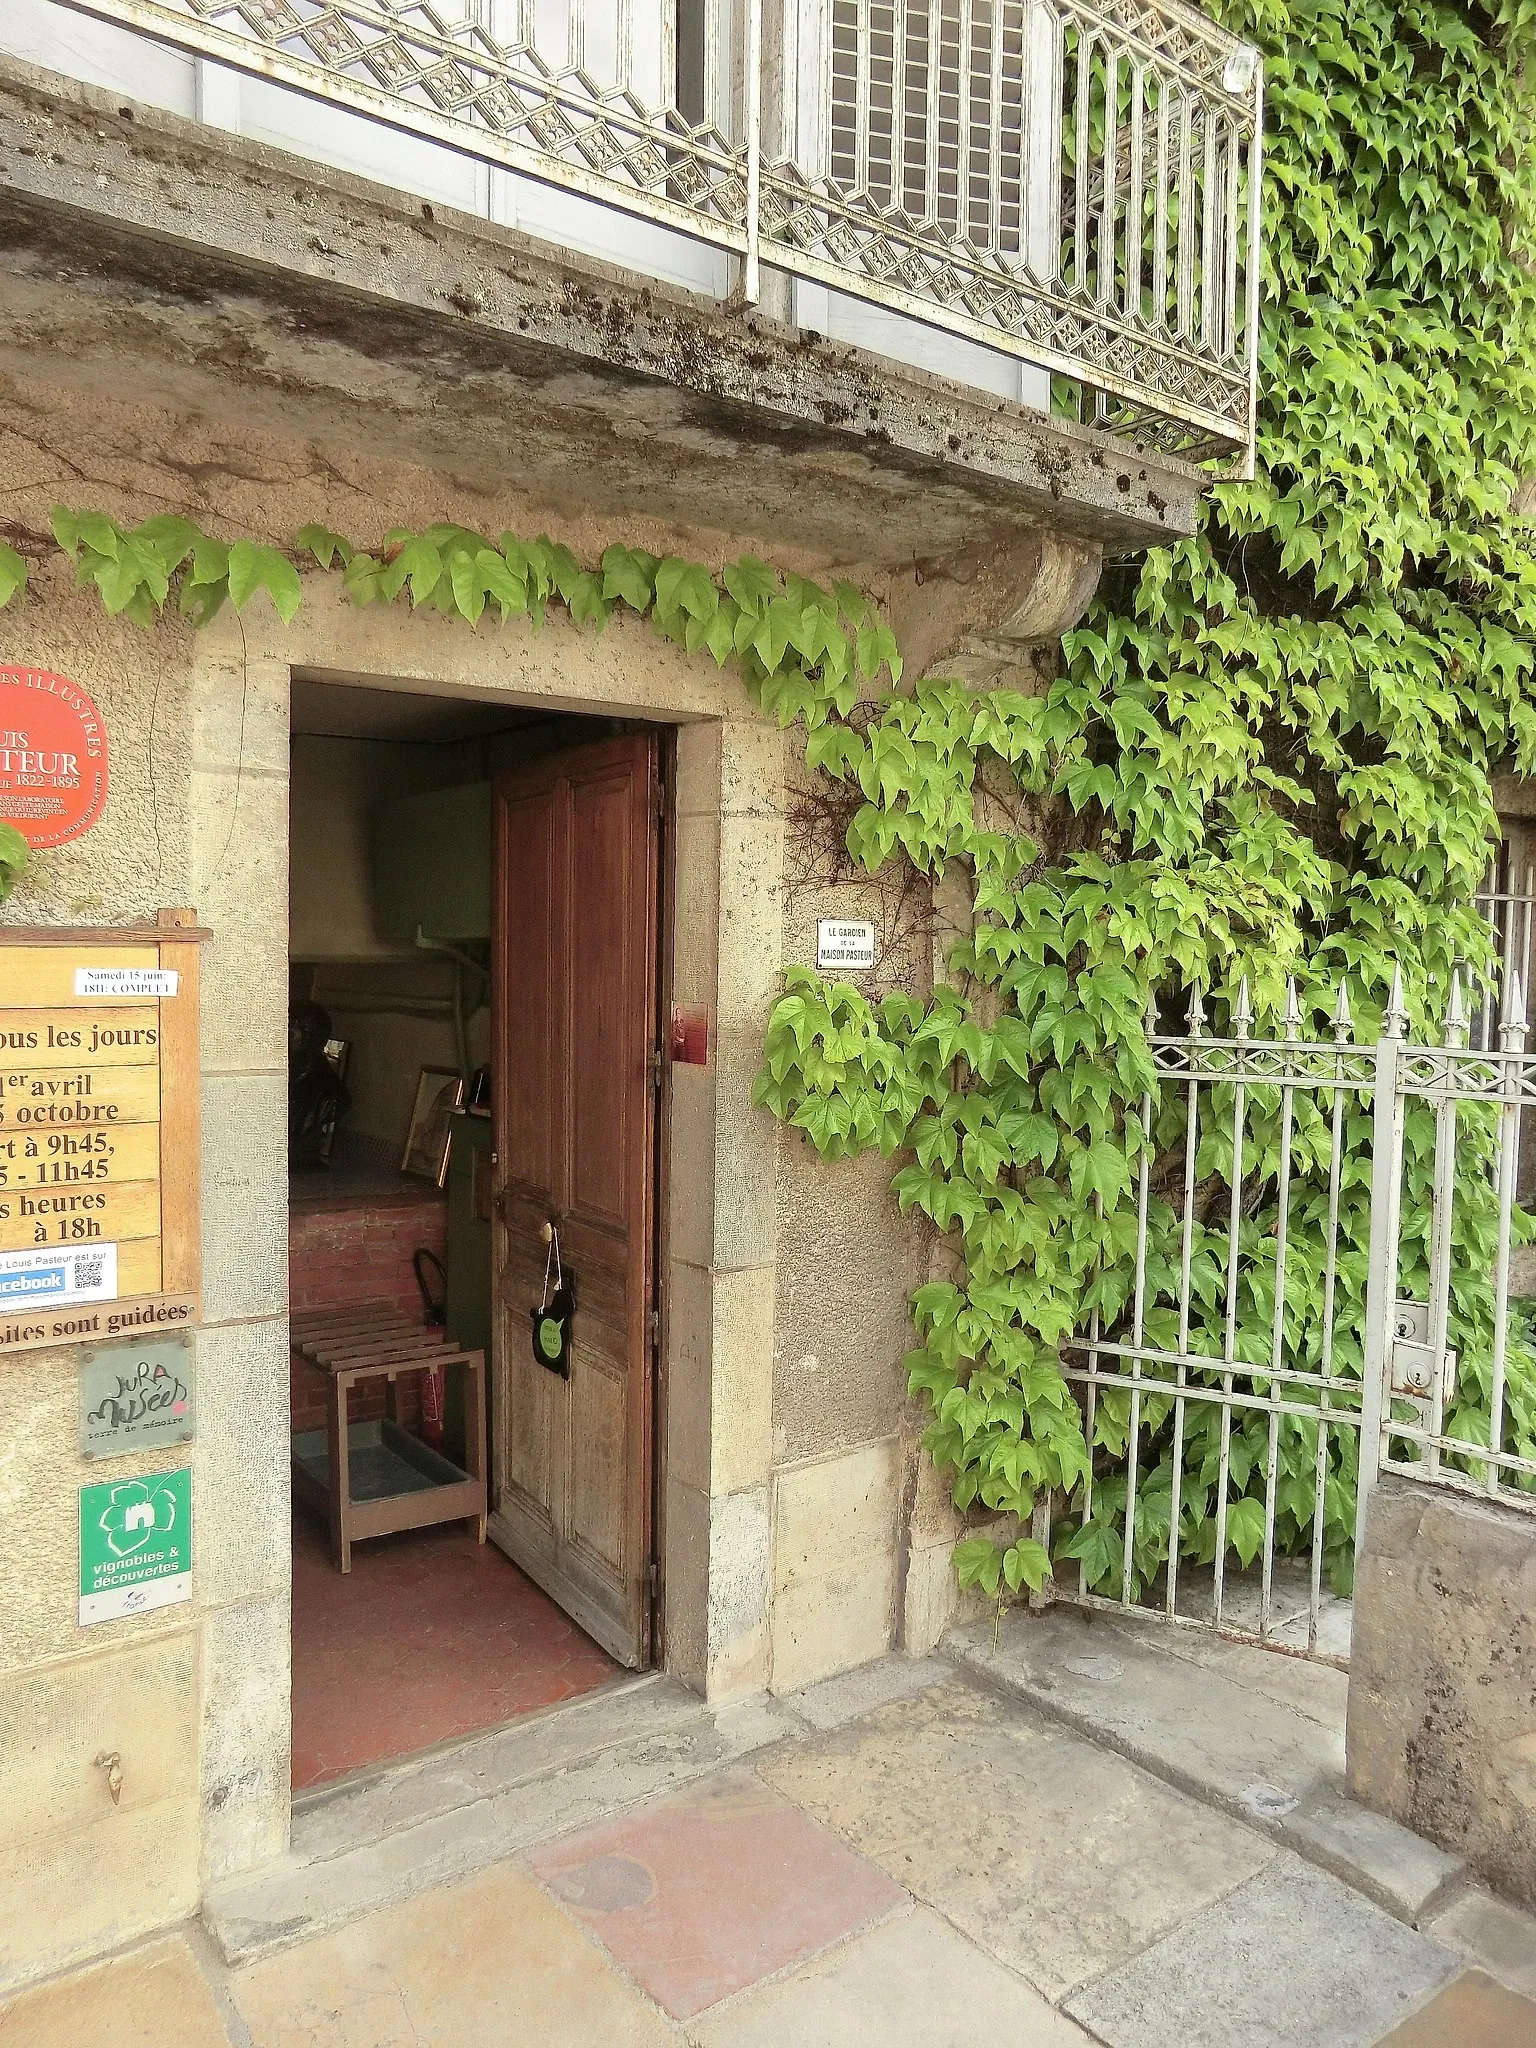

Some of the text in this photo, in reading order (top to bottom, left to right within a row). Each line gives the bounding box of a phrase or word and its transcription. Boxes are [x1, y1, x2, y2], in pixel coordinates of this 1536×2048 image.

[26, 673, 102, 758] ILLUSTRES
[16, 774, 80, 789] 1822-1895
[829, 928, 866, 937] LE GARDIEN
[821, 949, 872, 960] MAISON PASTEUR
[87, 971, 125, 980] Samedi
[129, 971, 141, 980] 15
[111, 984, 170, 994] COMPLET
[47, 1025, 82, 1047] les
[88, 1024, 157, 1052] jours
[31, 1074, 92, 1096] avril
[17, 1100, 119, 1122] octobre
[24, 1137, 39, 1157] à
[47, 1132, 115, 1156] 9h45,
[36, 1158, 109, 1183] 11h45
[20, 1193, 106, 1216] heures
[34, 1217, 101, 1242] à 18h
[6, 1259, 33, 1269] Louis
[35, 1255, 73, 1265] Pasteur
[75, 1253, 89, 1262] est
[92, 1252, 107, 1260] sur
[0, 1272, 62, 1294] cebook
[52, 1313, 100, 1337] sont
[107, 1303, 189, 1334] guidées
[88, 1417, 184, 1439] terre de mémoire
[93, 1546, 179, 1575] vignobles &
[93, 1561, 179, 1589] découvertes
